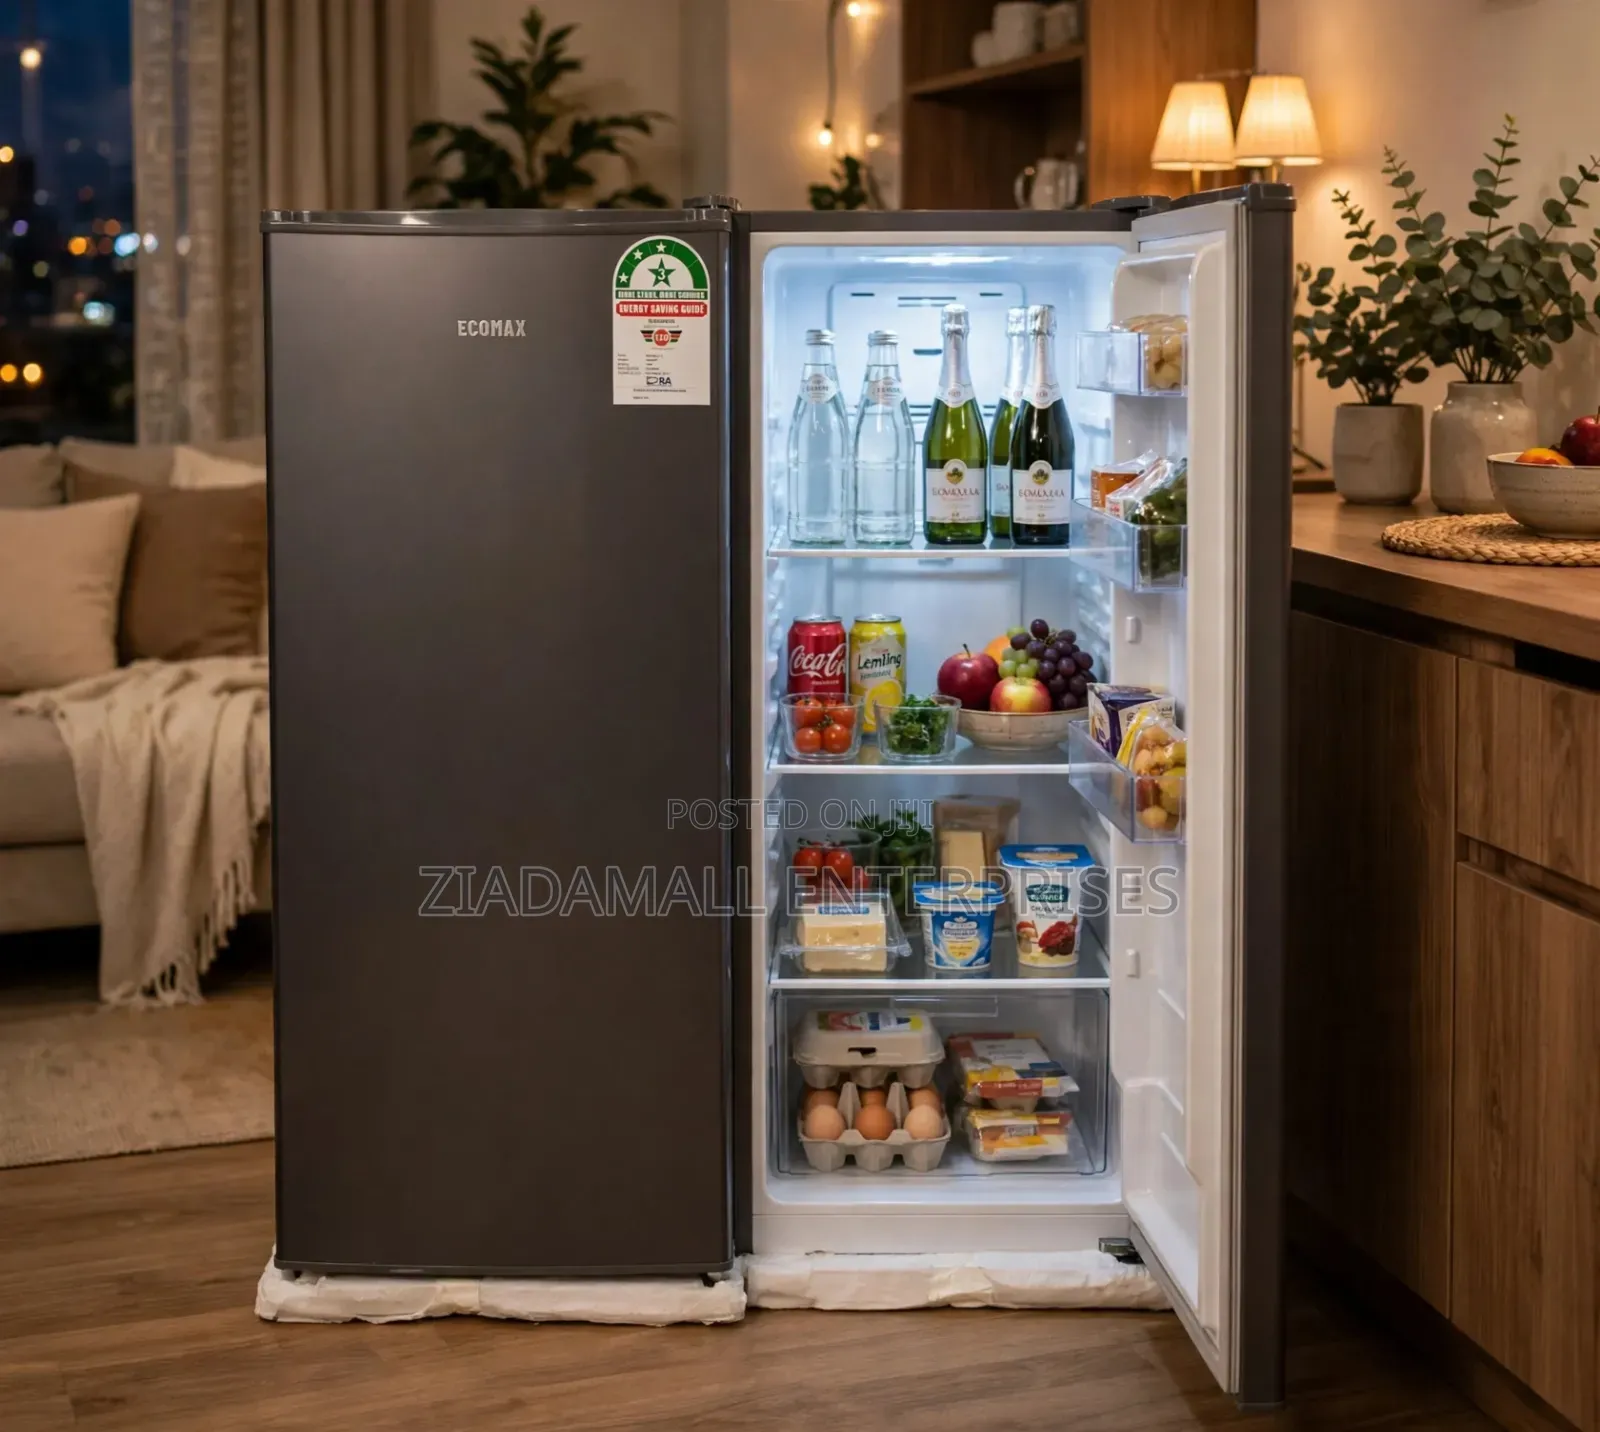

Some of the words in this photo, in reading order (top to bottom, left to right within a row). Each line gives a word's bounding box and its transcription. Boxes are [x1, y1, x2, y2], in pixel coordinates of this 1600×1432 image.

[657, 268, 666, 281] 3
[681, 303, 705, 314] GUIDE
[457, 319, 527, 337] ECOMAX
